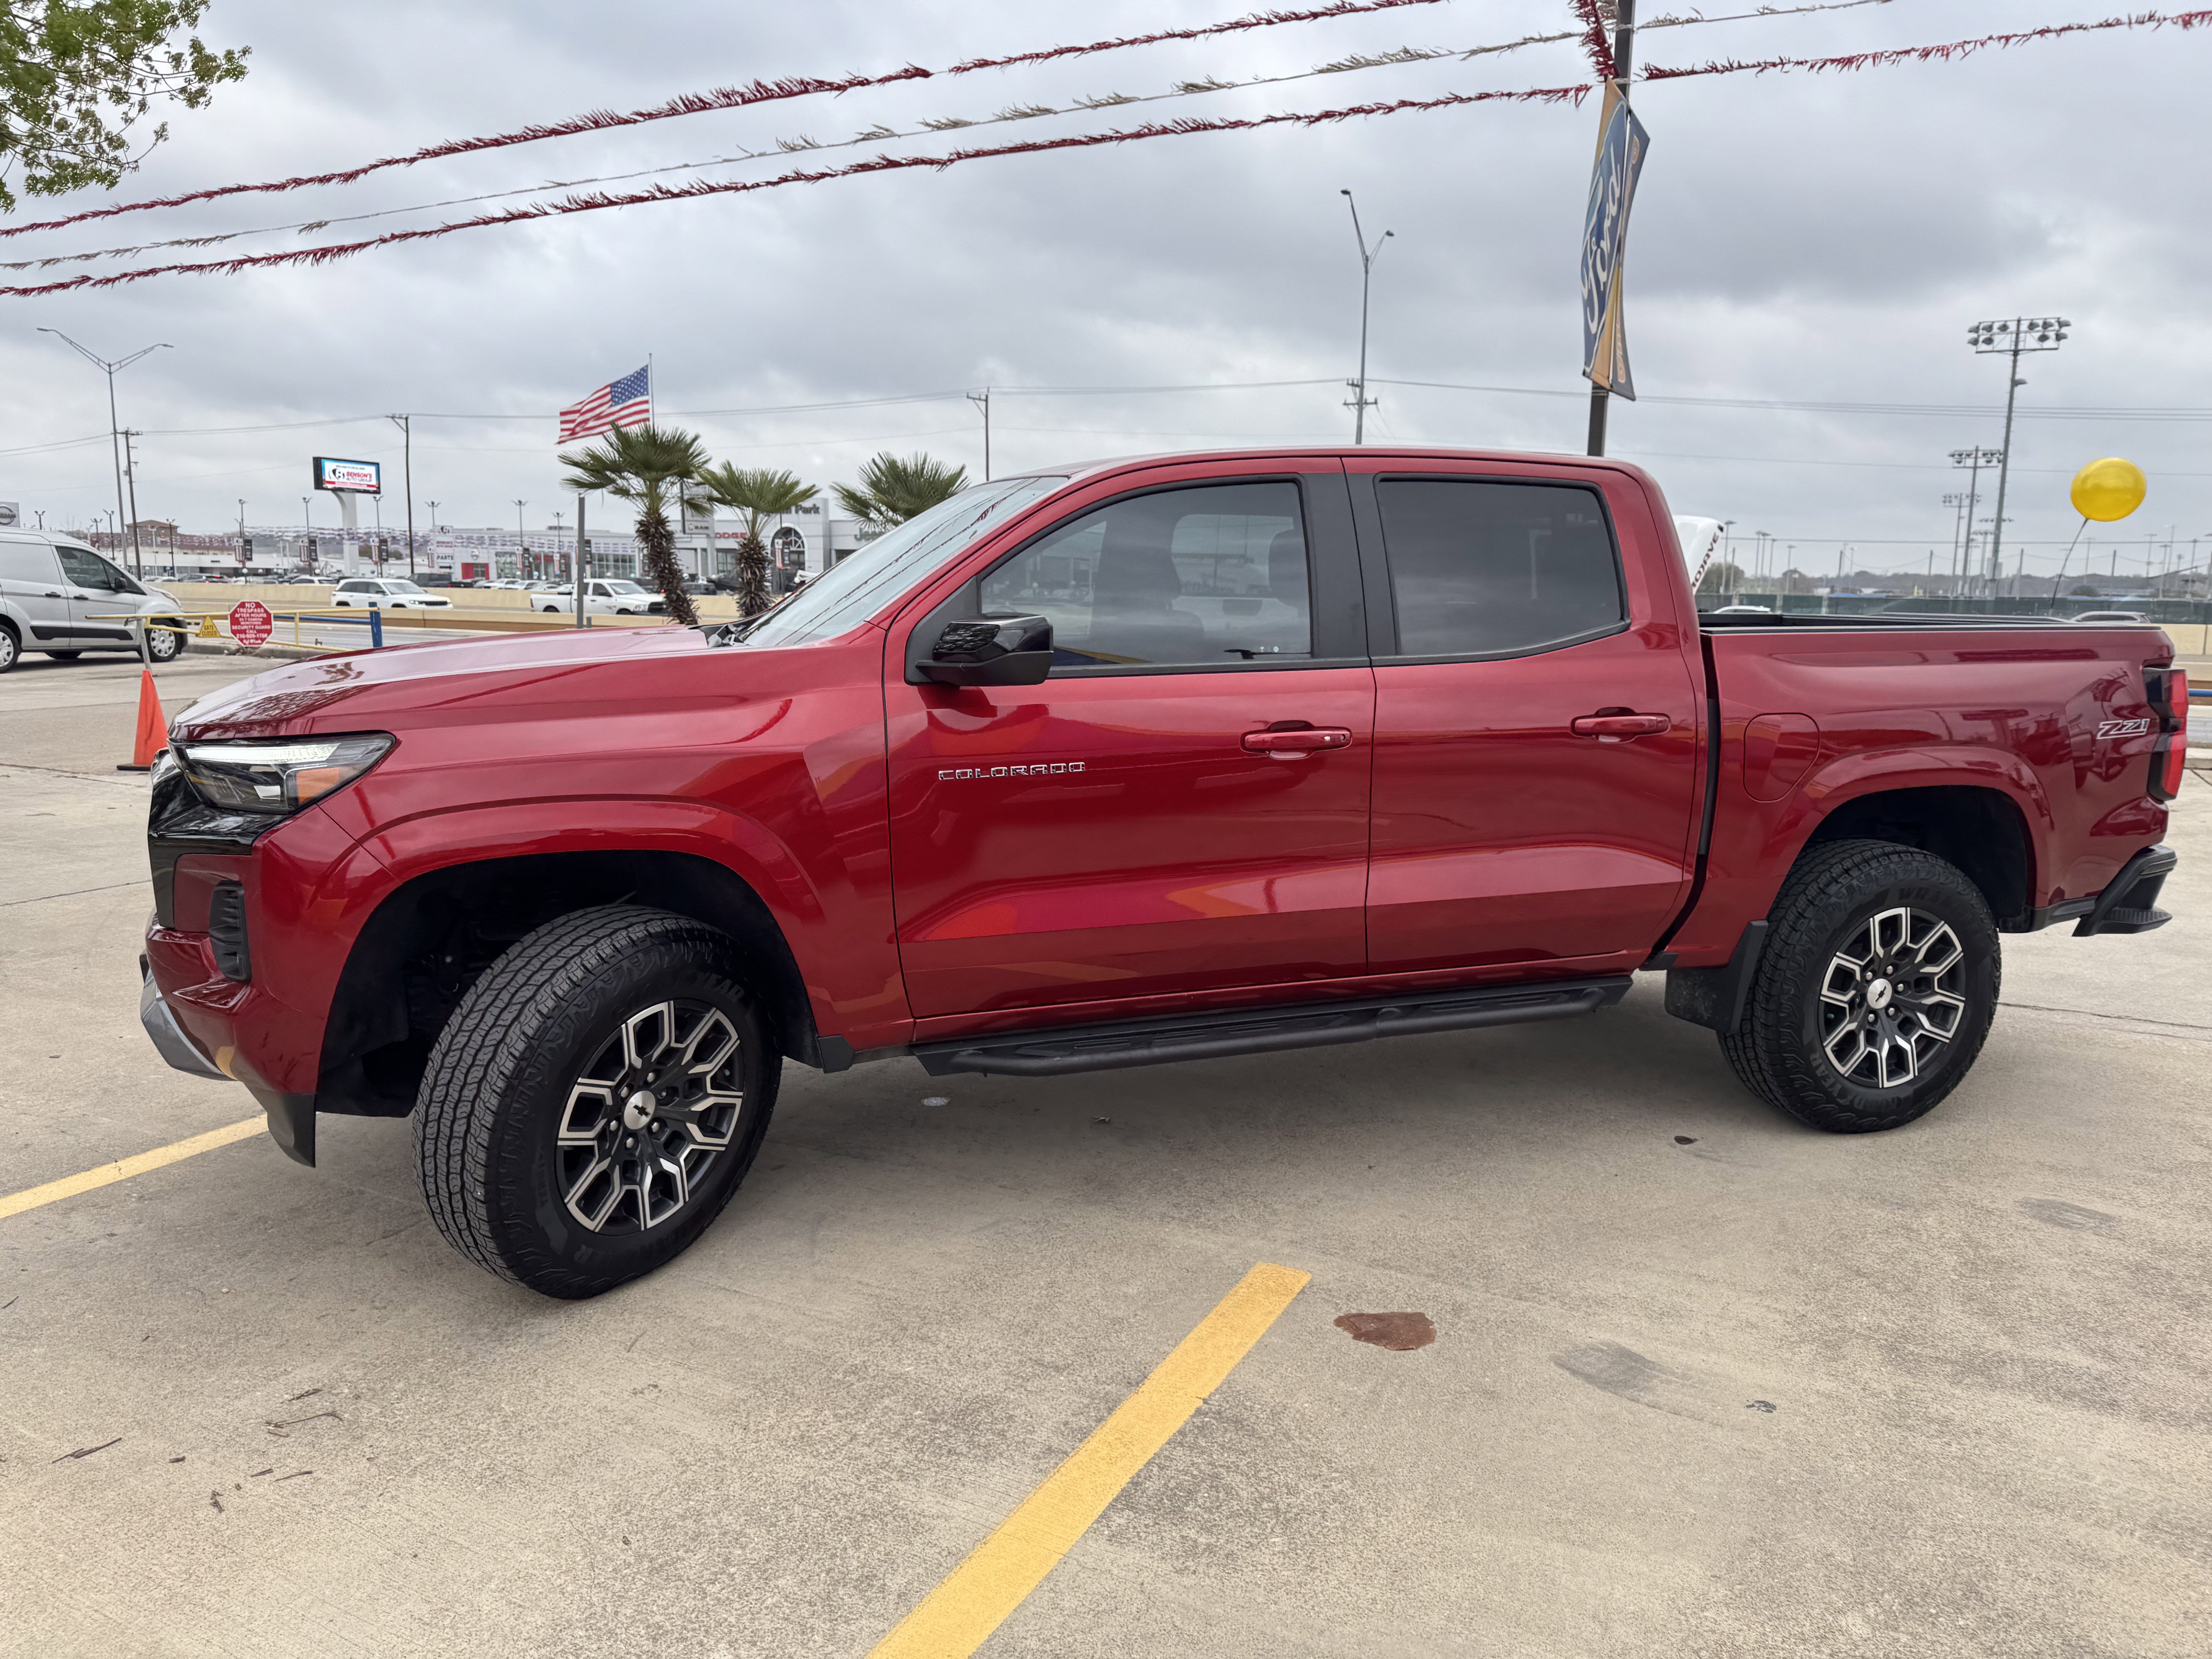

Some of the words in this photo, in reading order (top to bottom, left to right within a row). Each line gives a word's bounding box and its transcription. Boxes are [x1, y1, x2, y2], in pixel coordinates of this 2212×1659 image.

[1581, 141, 1621, 335] Ford
[795, 503, 820, 514] Park
[2097, 718, 2150, 739] Z71
[939, 762, 1085, 780] COLORADO
